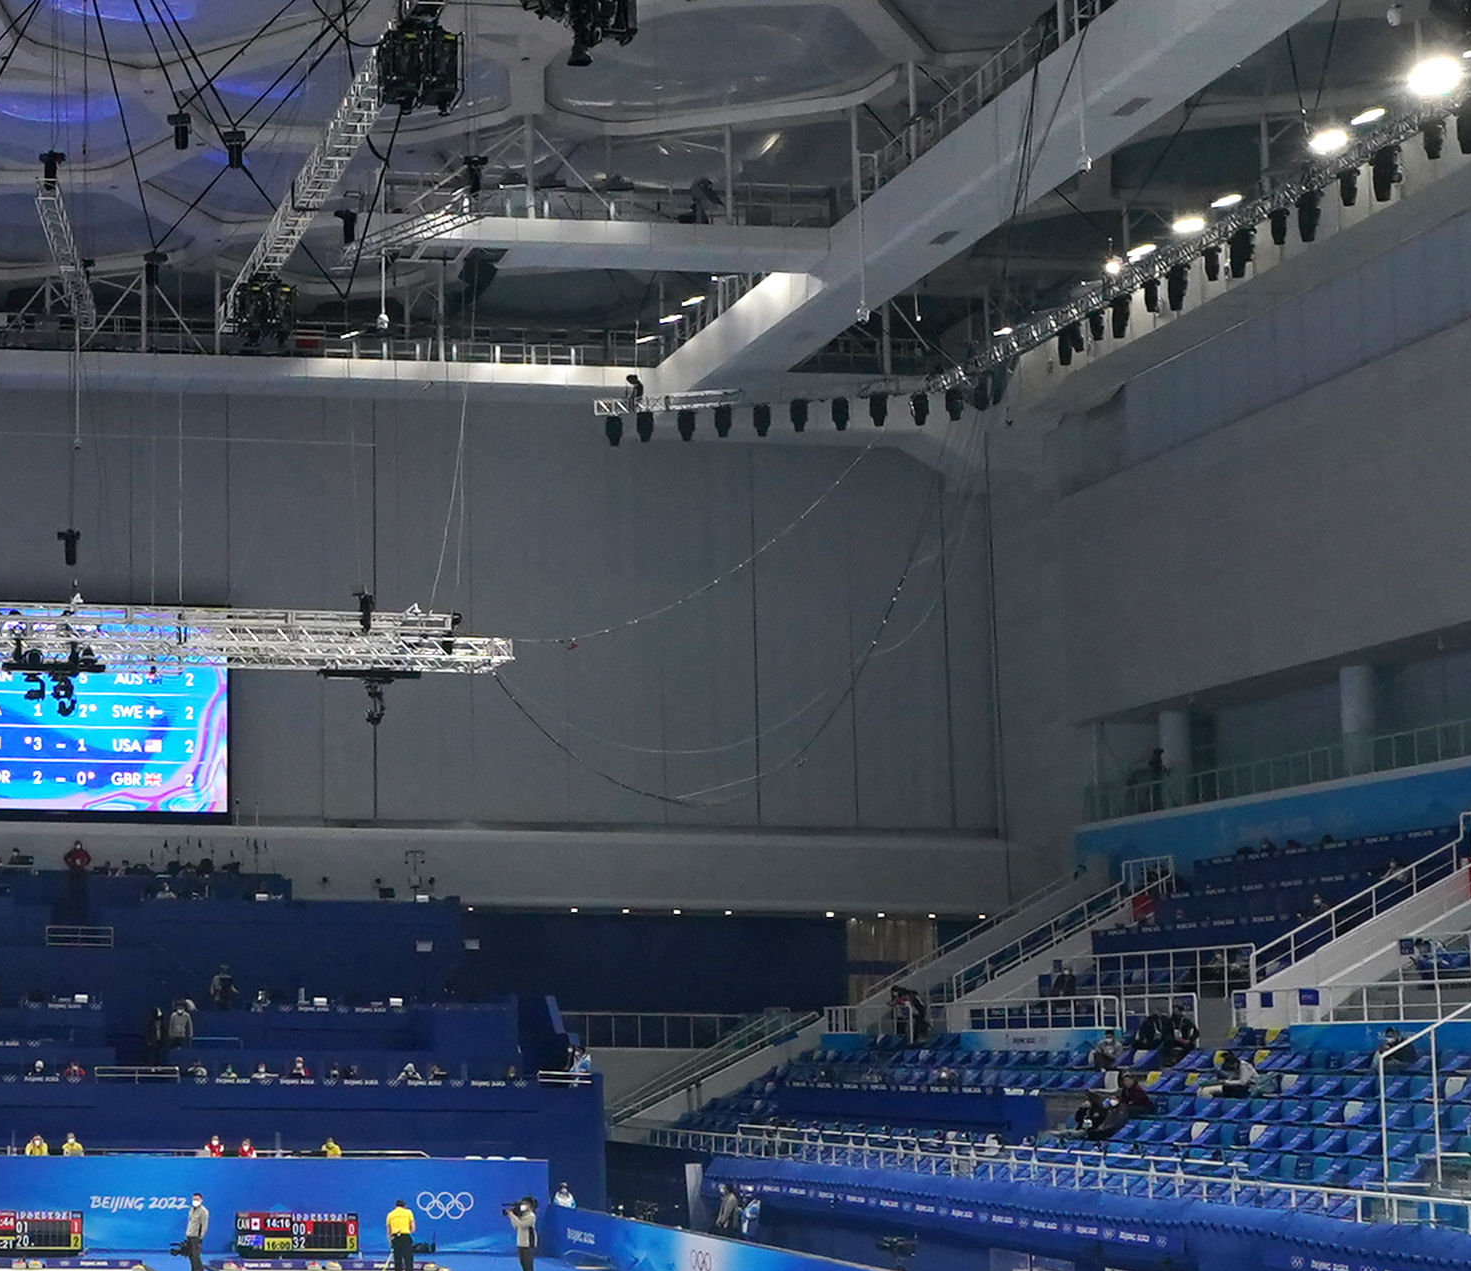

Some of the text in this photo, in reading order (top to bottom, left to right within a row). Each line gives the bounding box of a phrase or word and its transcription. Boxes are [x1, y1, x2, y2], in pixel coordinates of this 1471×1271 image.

[114, 673, 143, 685] AUS
[185, 674, 194, 686] 2
[34, 703, 42, 716] 1
[79, 705, 88, 718] 2
[112, 705, 143, 719] SWE
[185, 707, 194, 720] 2
[33, 737, 42, 751] 3
[78, 738, 86, 752] 1
[113, 739, 142, 753] USA
[185, 740, 194, 753] 2
[33, 771, 42, 784] 2
[76, 772, 88, 786] 0
[111, 772, 141, 787] GBR
[185, 773, 194, 787] 2
[91, 1196, 190, 1213] BEIJING 2022
[237, 1218, 355, 1235] CAN 0
[72, 1237, 79, 1248] 2
